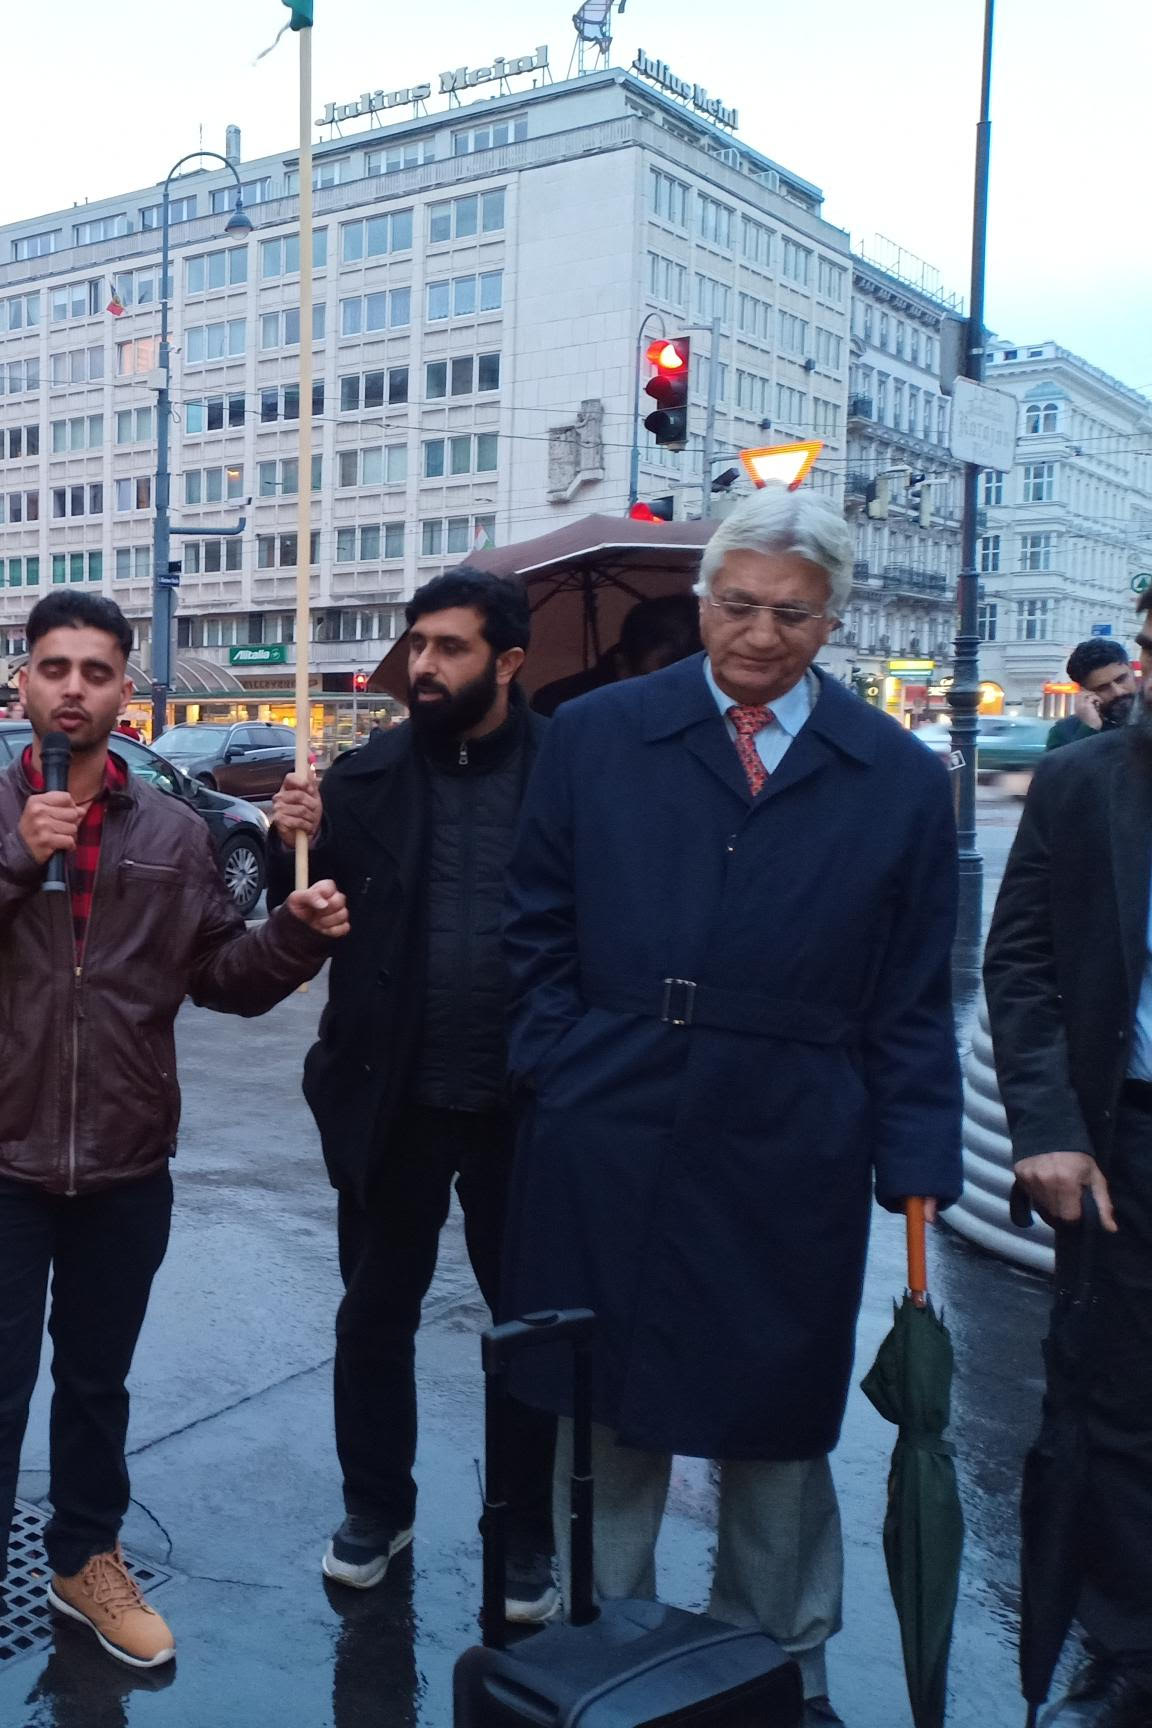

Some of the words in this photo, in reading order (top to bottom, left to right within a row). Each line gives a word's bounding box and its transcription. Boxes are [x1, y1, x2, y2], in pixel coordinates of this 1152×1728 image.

[315, 81, 431, 126] Julius
[438, 45, 548, 94] Meinl
[632, 48, 691, 100] Julius
[693, 83, 739, 130] Meinl
[232, 649, 271, 661] Alitalia
